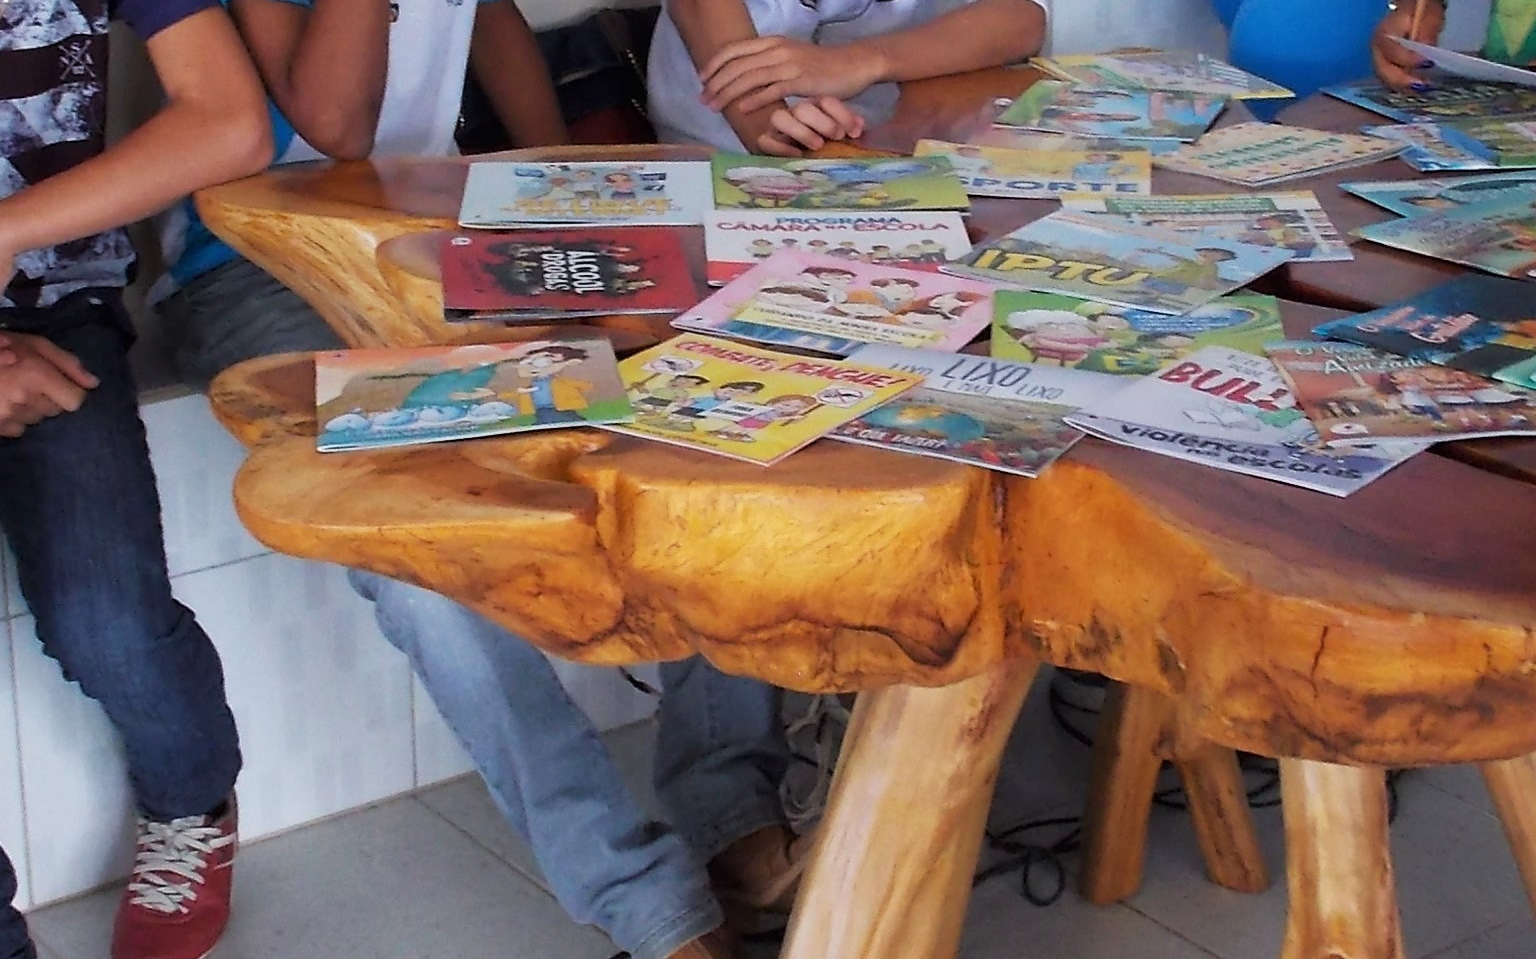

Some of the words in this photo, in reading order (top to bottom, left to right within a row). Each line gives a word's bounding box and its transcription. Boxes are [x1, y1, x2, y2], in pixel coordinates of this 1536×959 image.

[972, 247, 1153, 286] IPTU
[939, 358, 1033, 388] LIXO
[1015, 383, 1065, 401] LIXO
